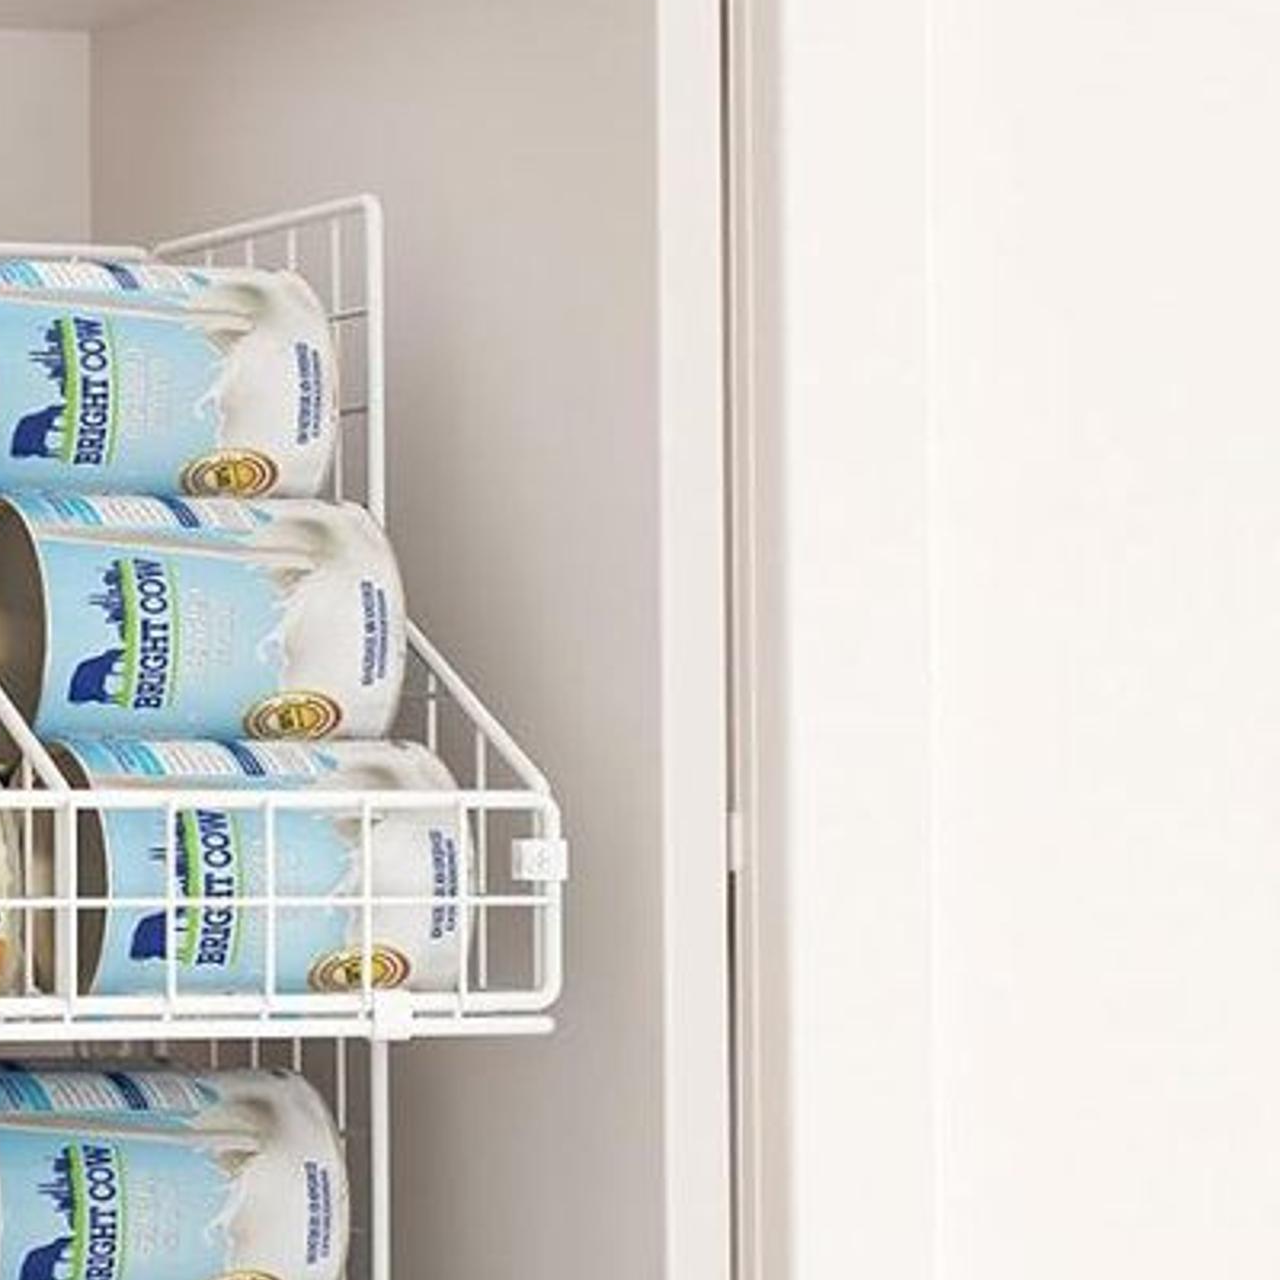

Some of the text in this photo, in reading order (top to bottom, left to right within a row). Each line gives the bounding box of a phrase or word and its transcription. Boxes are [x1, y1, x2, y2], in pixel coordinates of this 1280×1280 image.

[73, 316, 111, 467] BRIGHT COW
[133, 556, 170, 711] BRIGHT COW
[195, 808, 232, 869] COW
[82, 1144, 117, 1203] COW
